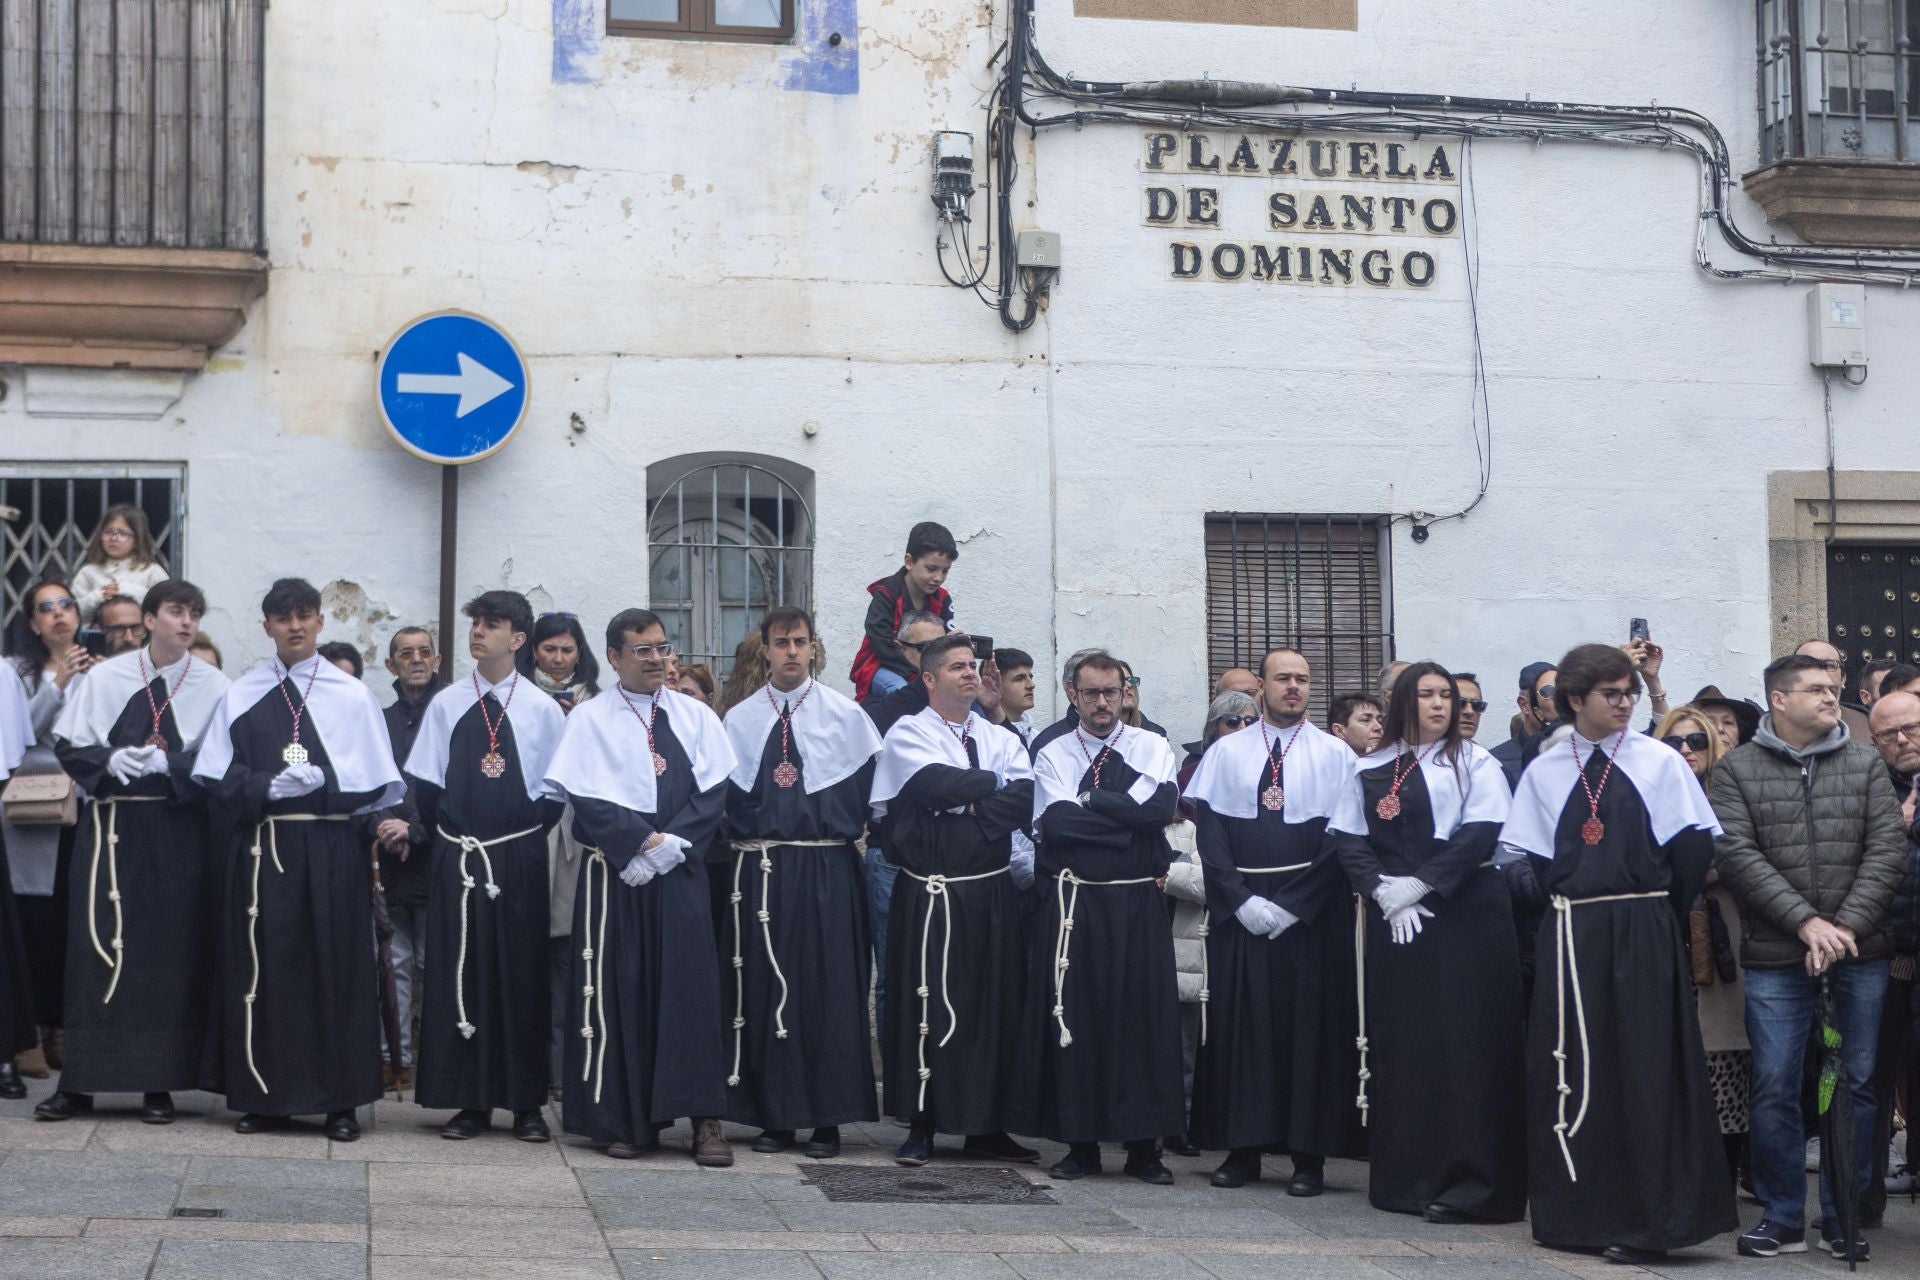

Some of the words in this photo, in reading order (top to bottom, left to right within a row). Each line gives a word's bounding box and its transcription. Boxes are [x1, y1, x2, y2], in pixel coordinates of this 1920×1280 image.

[1145, 133, 1456, 181] PLAZUELA
[1146, 187, 1219, 226] DE
[1269, 192, 1458, 235] SANTO
[1170, 242, 1435, 287] DOMINGO
